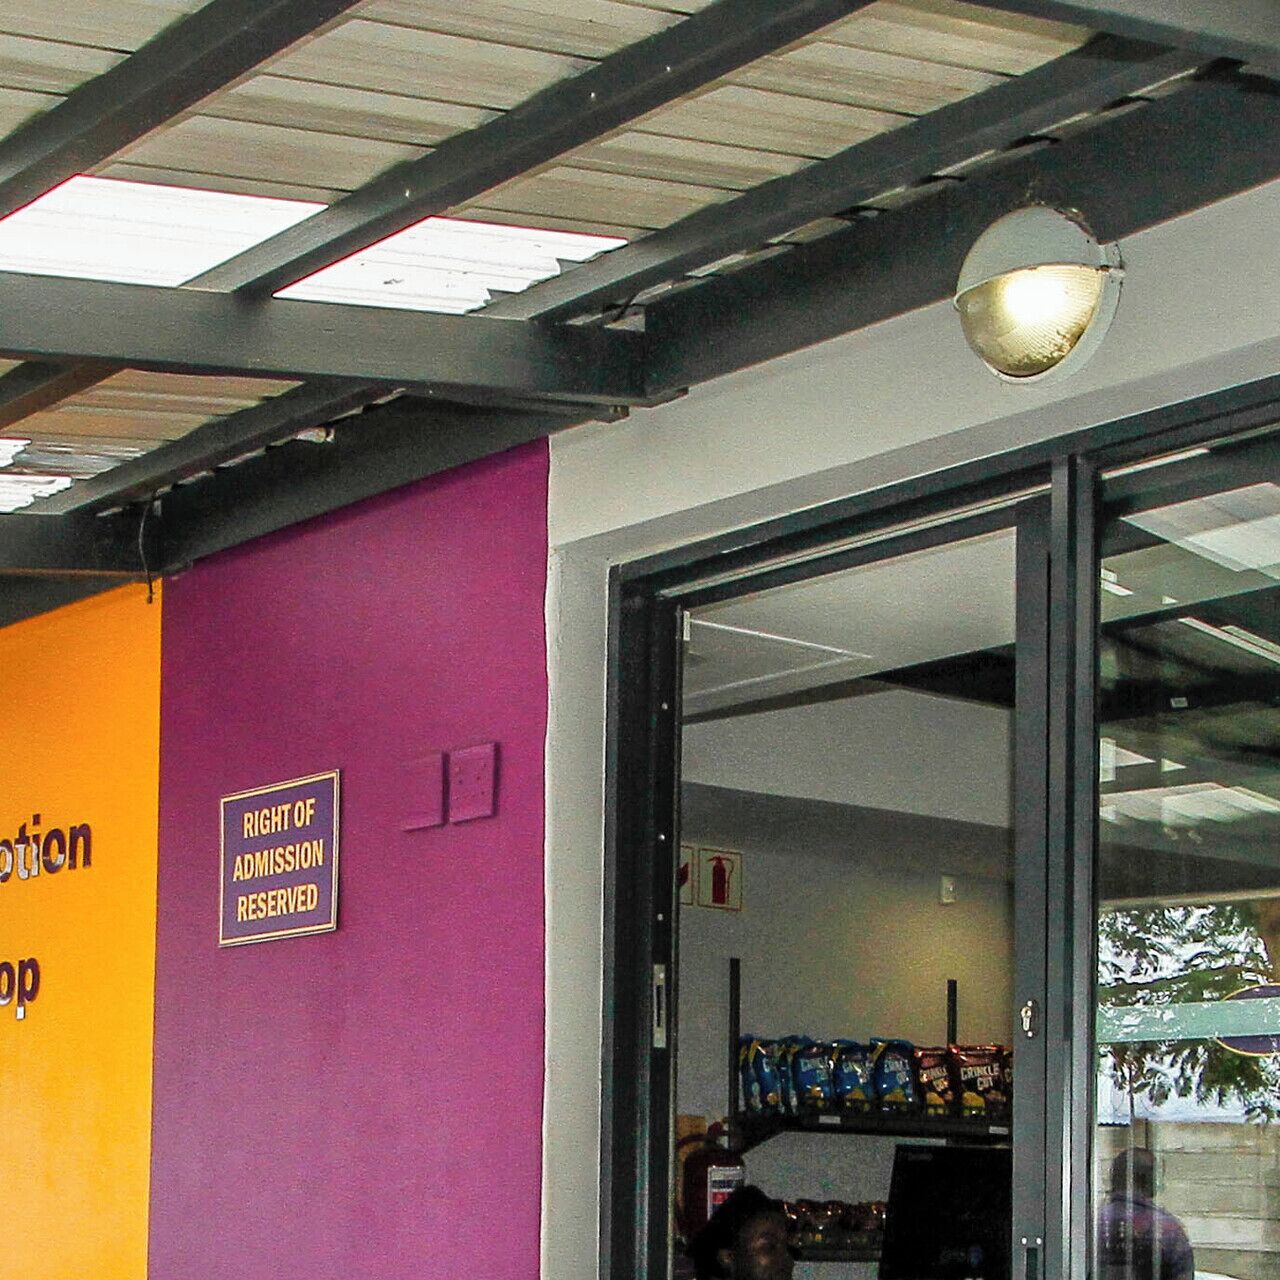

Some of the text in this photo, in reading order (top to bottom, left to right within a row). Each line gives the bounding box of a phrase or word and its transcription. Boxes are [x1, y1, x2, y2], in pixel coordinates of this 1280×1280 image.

[243, 798, 316, 838] RIGHT OF
[233, 839, 324, 881] ADMISSION
[237, 883, 318, 922] RESERVED
[960, 1062, 1001, 1081] CRINKLE
